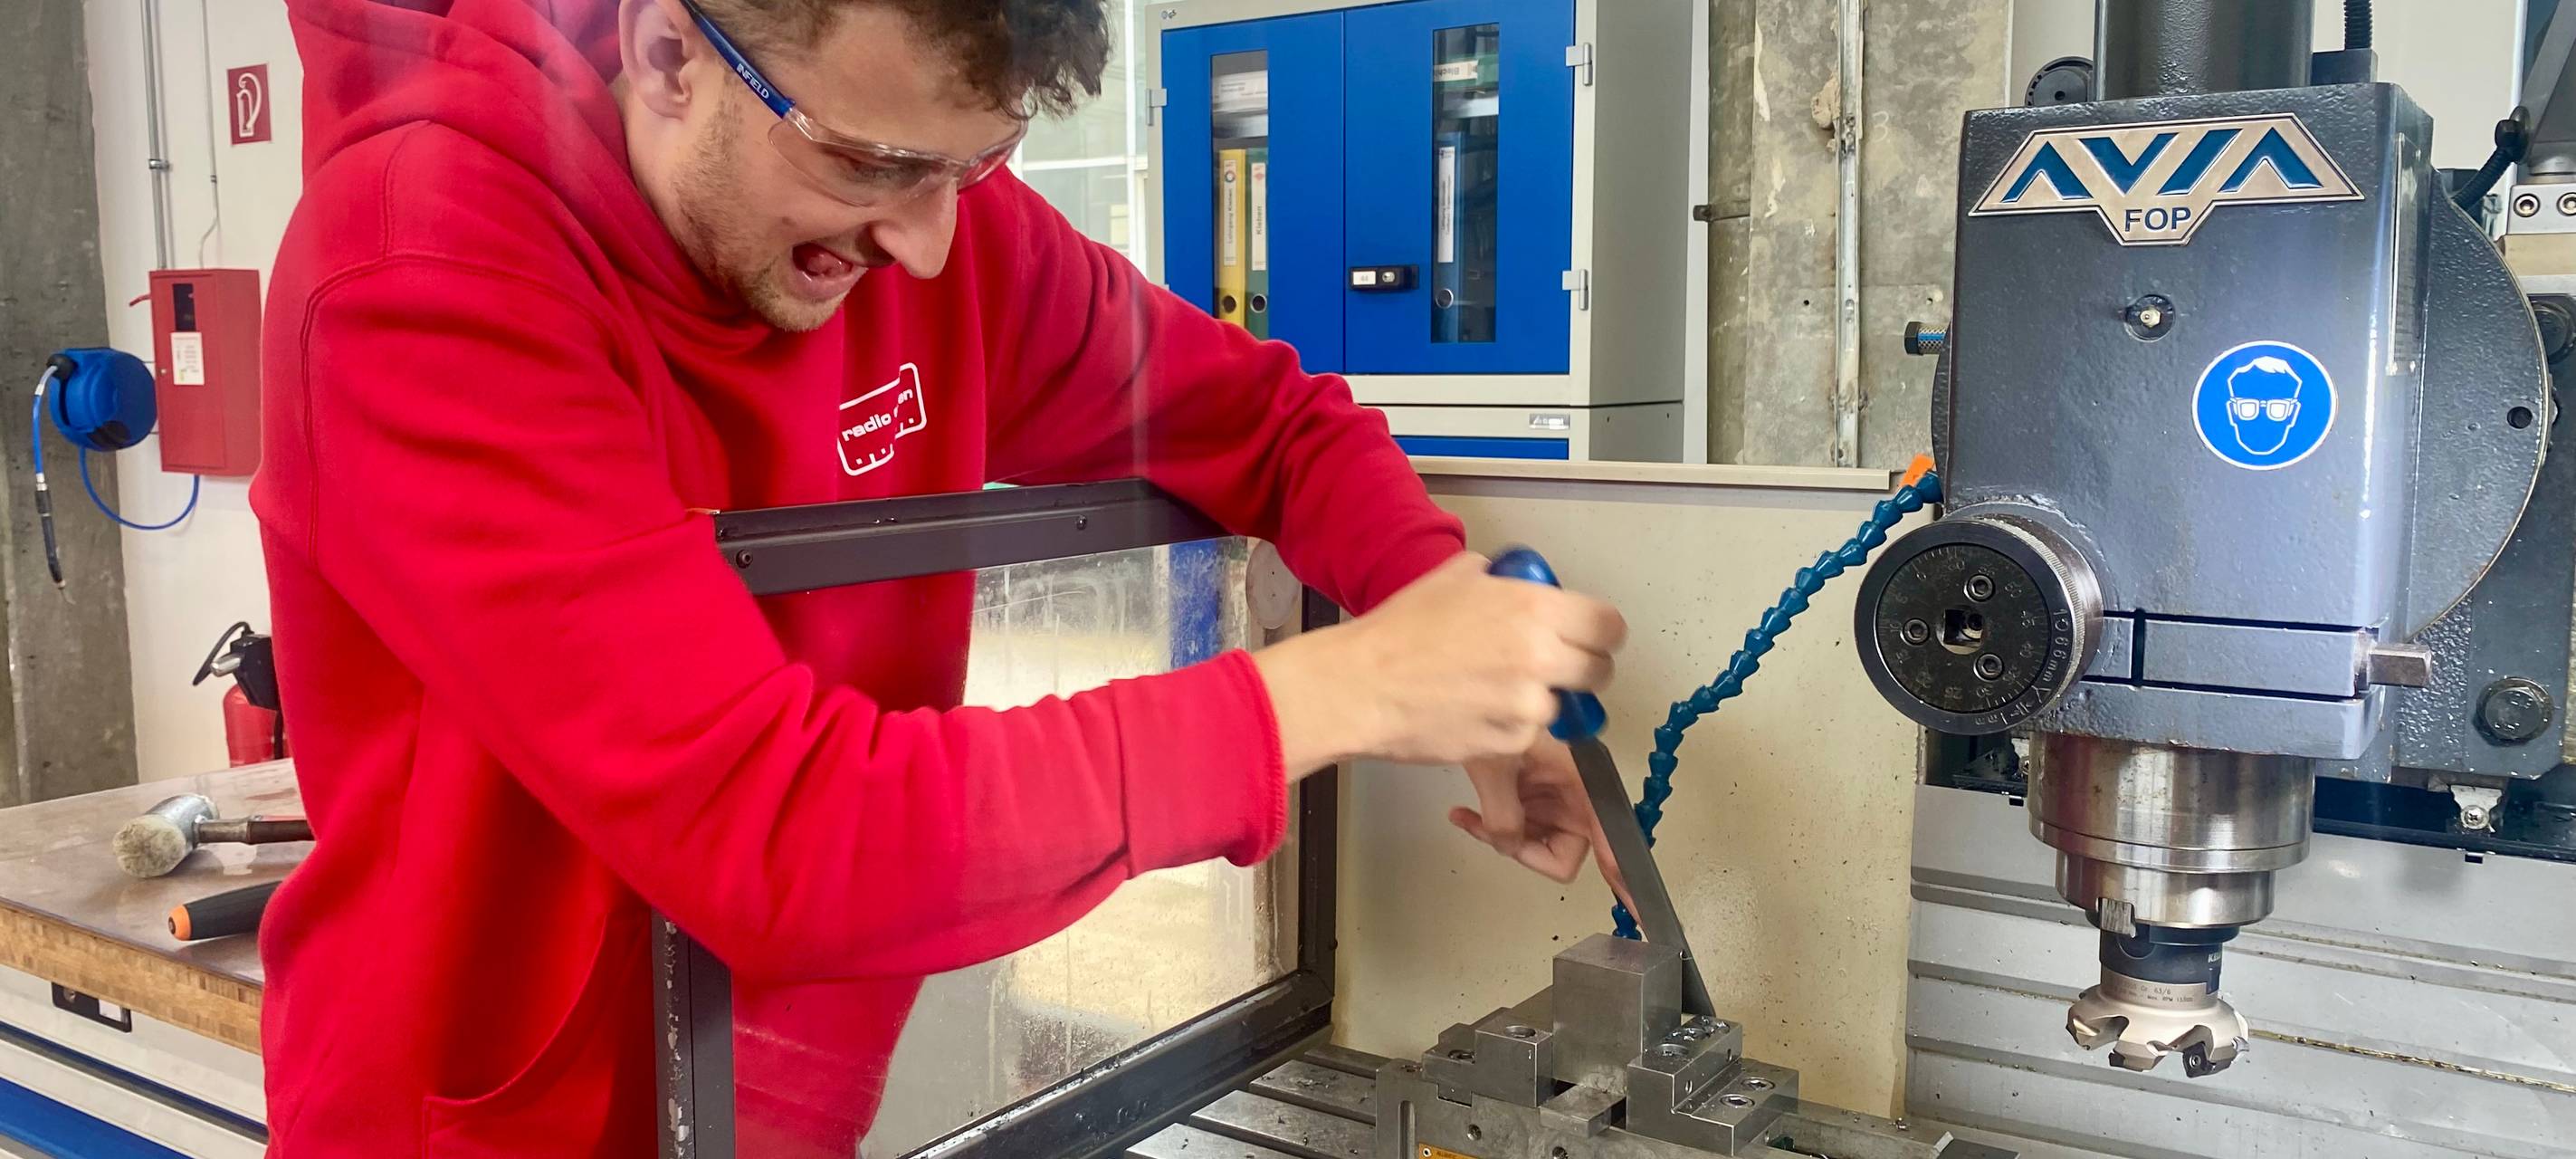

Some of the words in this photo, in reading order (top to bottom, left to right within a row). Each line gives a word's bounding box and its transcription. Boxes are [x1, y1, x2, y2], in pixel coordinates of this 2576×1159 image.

[737, 62, 769, 100] INFIELD
[2000, 127, 2324, 204] AVIA
[2123, 206, 2191, 234] FOP
[842, 413, 892, 442] radio
